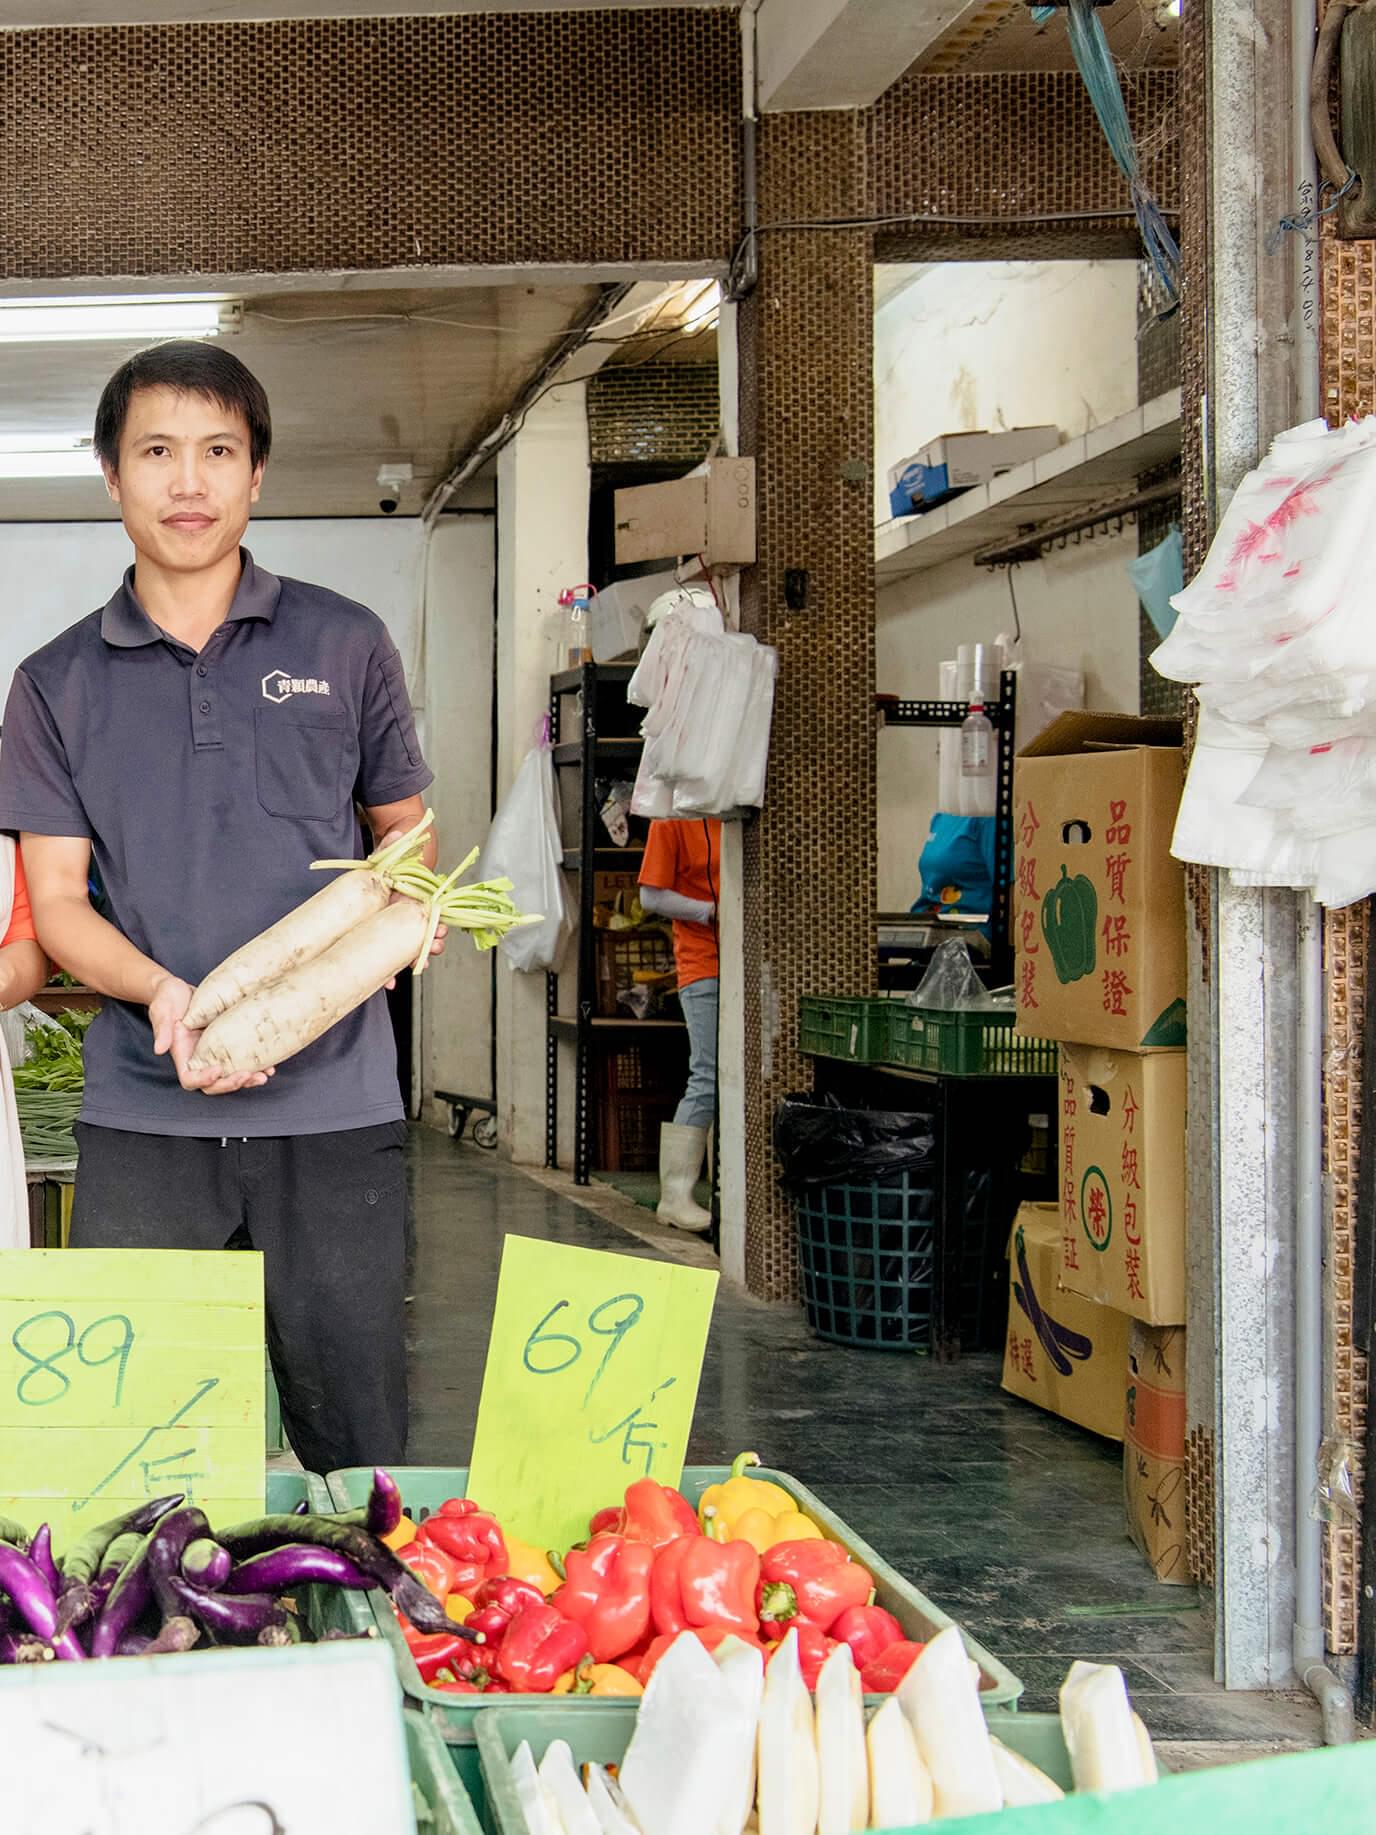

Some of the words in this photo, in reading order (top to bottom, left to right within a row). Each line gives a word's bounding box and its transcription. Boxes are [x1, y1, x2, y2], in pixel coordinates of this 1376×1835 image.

[1019, 801, 1041, 1009] 分級包裝
[1102, 799, 1133, 1016] 品質保證
[1121, 1084, 1145, 1300] 分級包裝
[12, 1310, 136, 1408] 89
[524, 1292, 645, 1410] 69
